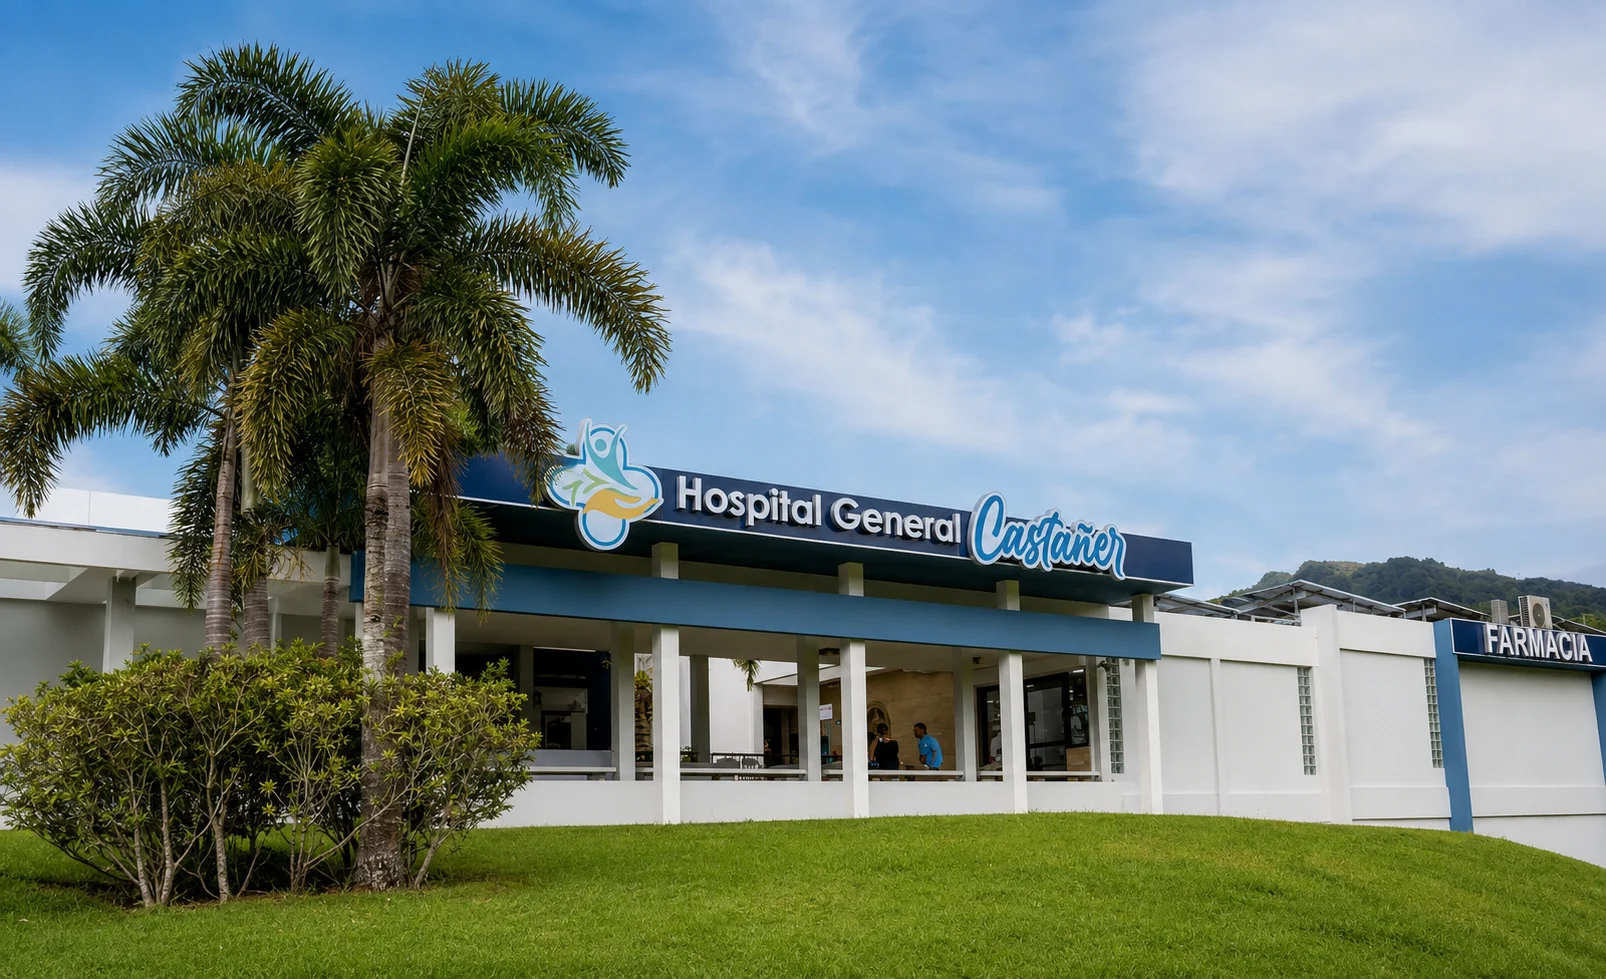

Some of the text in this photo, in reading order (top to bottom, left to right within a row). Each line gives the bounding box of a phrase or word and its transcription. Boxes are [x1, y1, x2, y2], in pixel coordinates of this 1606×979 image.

[677, 475, 1126, 580] Hospital General Castañer
[1484, 623, 1593, 662] FARMACIA
